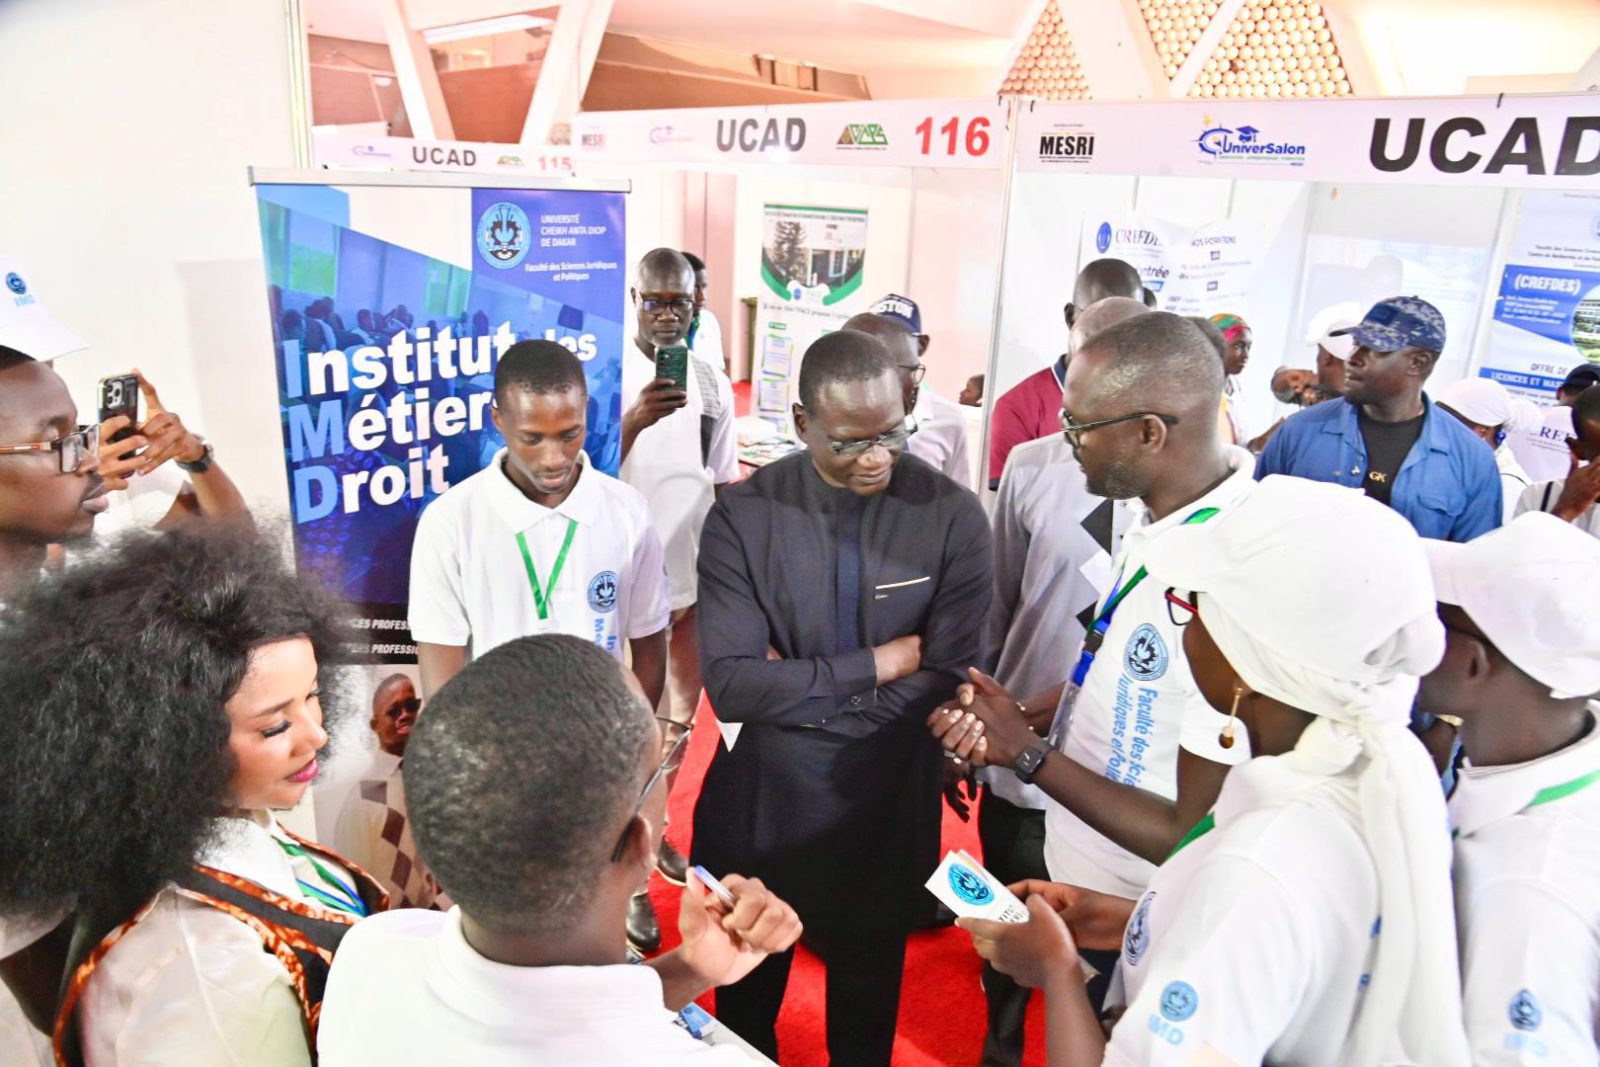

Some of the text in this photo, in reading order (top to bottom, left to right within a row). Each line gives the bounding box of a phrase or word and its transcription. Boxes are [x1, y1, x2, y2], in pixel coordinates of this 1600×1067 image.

[716, 117, 807, 152] UCAD
[915, 116, 991, 157] 116
[1039, 136, 1095, 155] MESRI
[1222, 133, 1306, 155] UniverSalon
[1369, 117, 1600, 176] UCAD
[412, 146, 477, 166] UCAD
[538, 156, 573, 171] 115
[541, 238, 577, 247] DE DAKAR
[568, 227, 587, 235] ANTA
[588, 226, 607, 235] DIOP
[283, 320, 516, 399] Institut
[288, 387, 497, 463] Métier
[293, 443, 449, 525] Droit
[1135, 687, 1159, 735] Faculté
[1130, 734, 1150, 762] des
